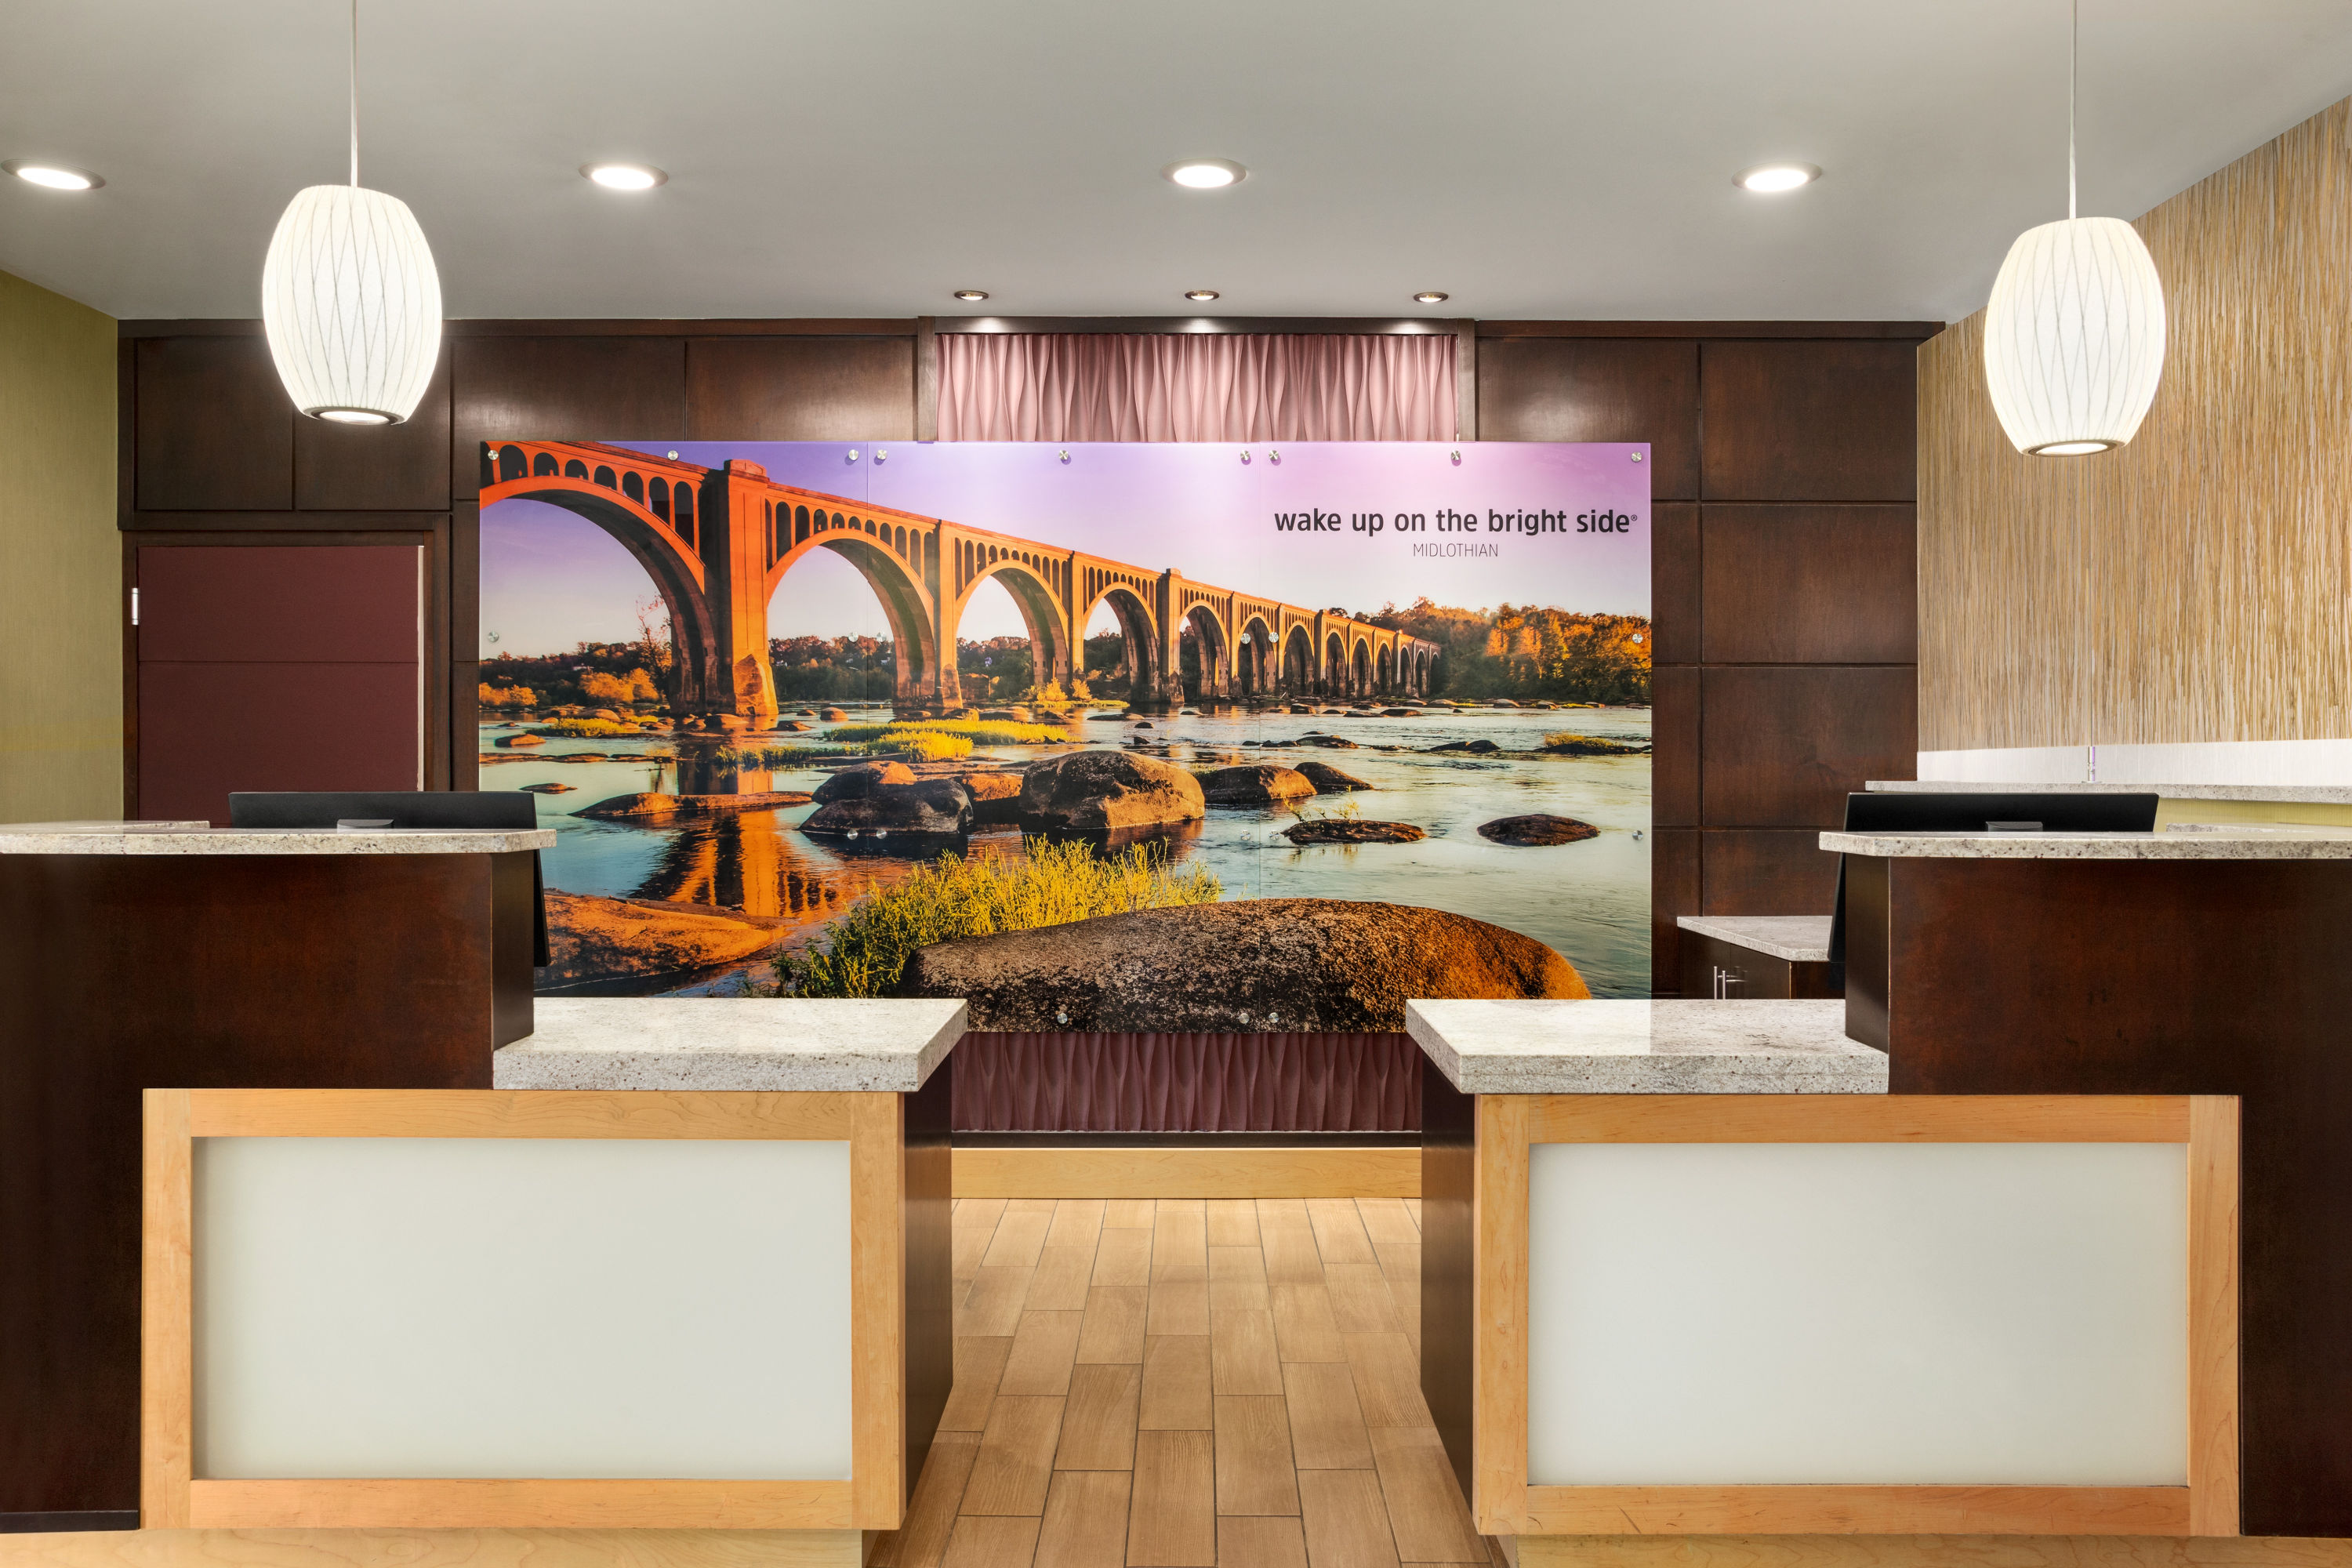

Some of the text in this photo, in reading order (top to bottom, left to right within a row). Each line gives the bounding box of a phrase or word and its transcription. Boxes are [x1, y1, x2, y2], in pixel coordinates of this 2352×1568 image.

[1274, 507, 1341, 532] wake
[1352, 513, 1385, 538] up
[1394, 513, 1426, 532] on
[1435, 507, 1479, 533] the
[1488, 508, 1567, 537] bright
[1413, 543, 1498, 557] MIDLOTHIAN
